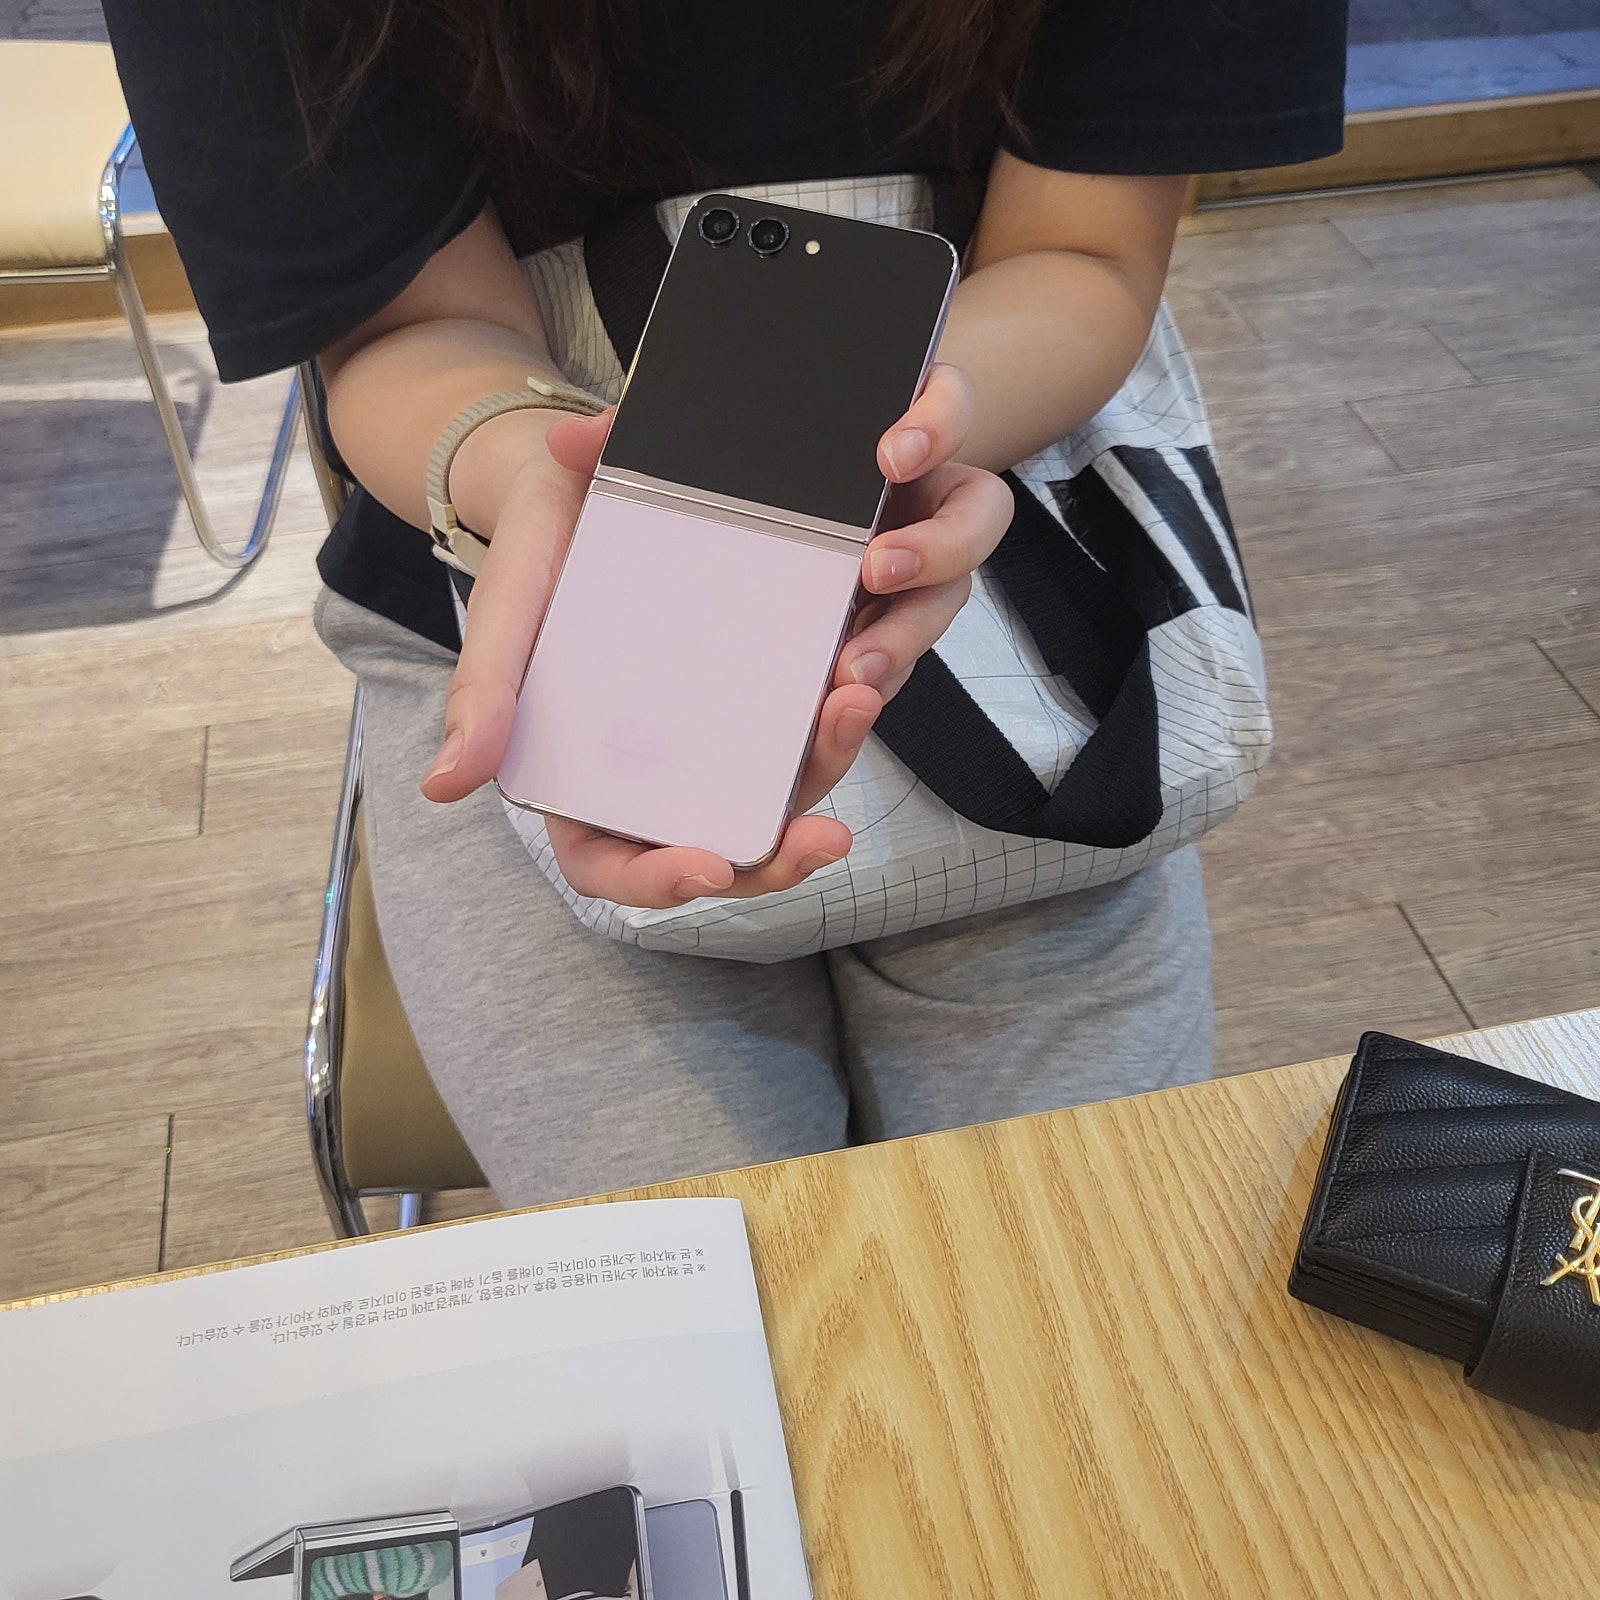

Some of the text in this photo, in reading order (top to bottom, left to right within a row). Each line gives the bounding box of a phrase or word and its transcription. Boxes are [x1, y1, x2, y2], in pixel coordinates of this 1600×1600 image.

[600, 1252, 636, 1267] 소개된
[640, 1249, 676, 1263] 책자에
[506, 1265, 543, 1280] 이해를
[547, 1257, 596, 1273] 이미지는
[642, 1264, 679, 1278] 책자에
[479, 1270, 503, 1285] 돕기
[560, 1272, 598, 1288] 내용은
[602, 1268, 638, 1282] 소개된
[410, 1281, 447, 1300] 연출된
[450, 1276, 475, 1291] 위해
[532, 1277, 557, 1293] 향후
[357, 1290, 407, 1310] 이미지로
[476, 1283, 529, 1301] 시장동향,
[317, 1300, 354, 1319] 실제와
[411, 1293, 473, 1315] 개발경과에
[275, 1310, 314, 1328] 차이가
[342, 1312, 379, 1330] 변경될
[383, 1306, 407, 1321] 따라
[247, 1317, 273, 1333] 있을
[175, 1327, 228, 1348] 있습니다.
[269, 1323, 323, 1345] 있습니다.
